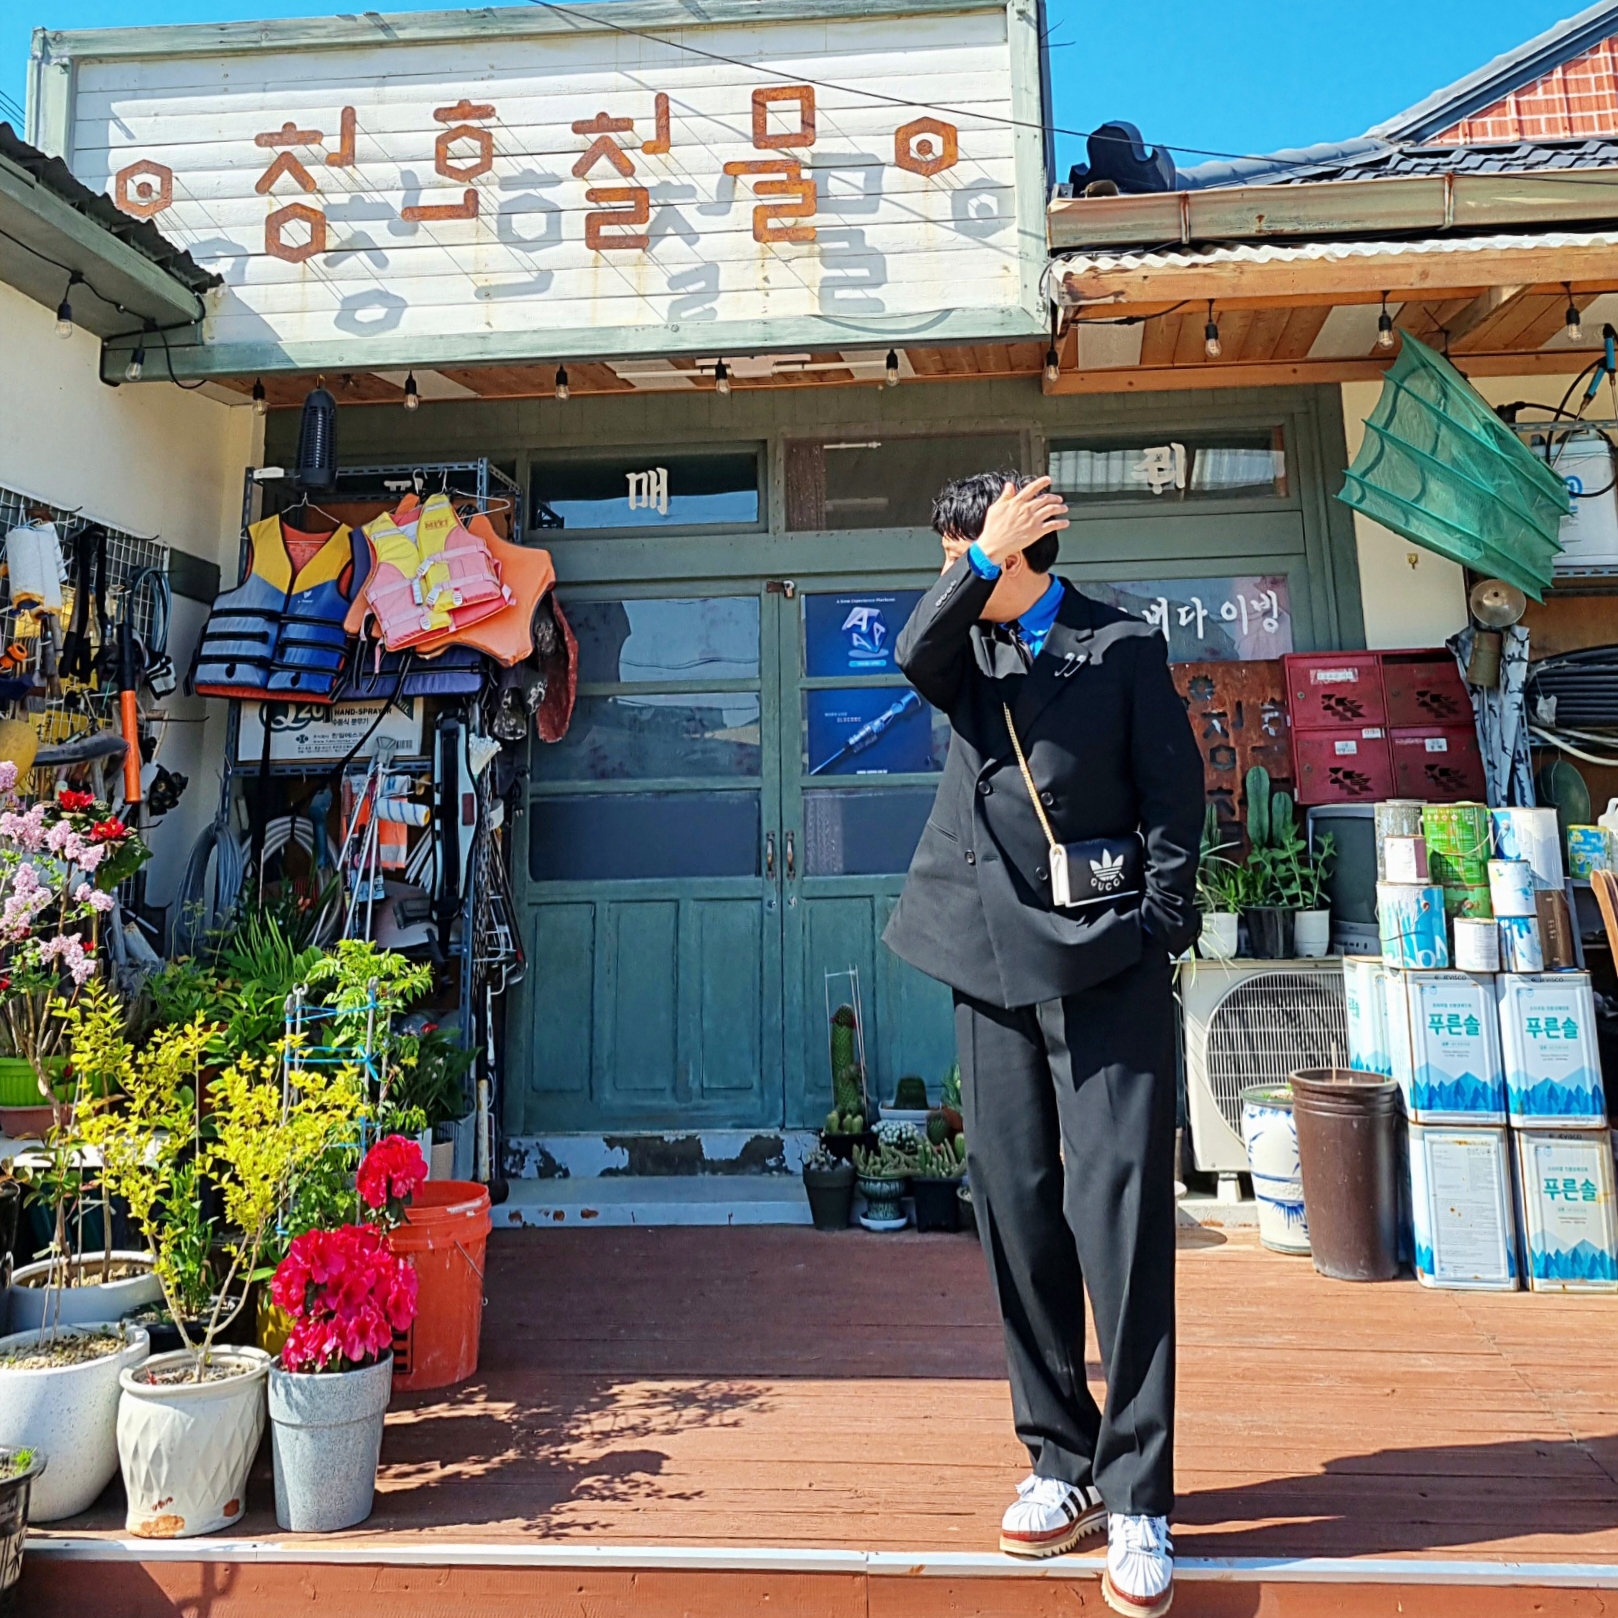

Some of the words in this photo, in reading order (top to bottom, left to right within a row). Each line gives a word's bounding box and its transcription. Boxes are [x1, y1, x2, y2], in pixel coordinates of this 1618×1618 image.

[253, 84, 818, 263] 청호철물
[625, 467, 668, 515] 매
[334, 707, 392, 716] HAND-SPRAYR
[1428, 1013, 1480, 1036] 푸른솔
[1525, 1016, 1579, 1040] 푸른솔
[1543, 1178, 1598, 1202] 푸른솔
